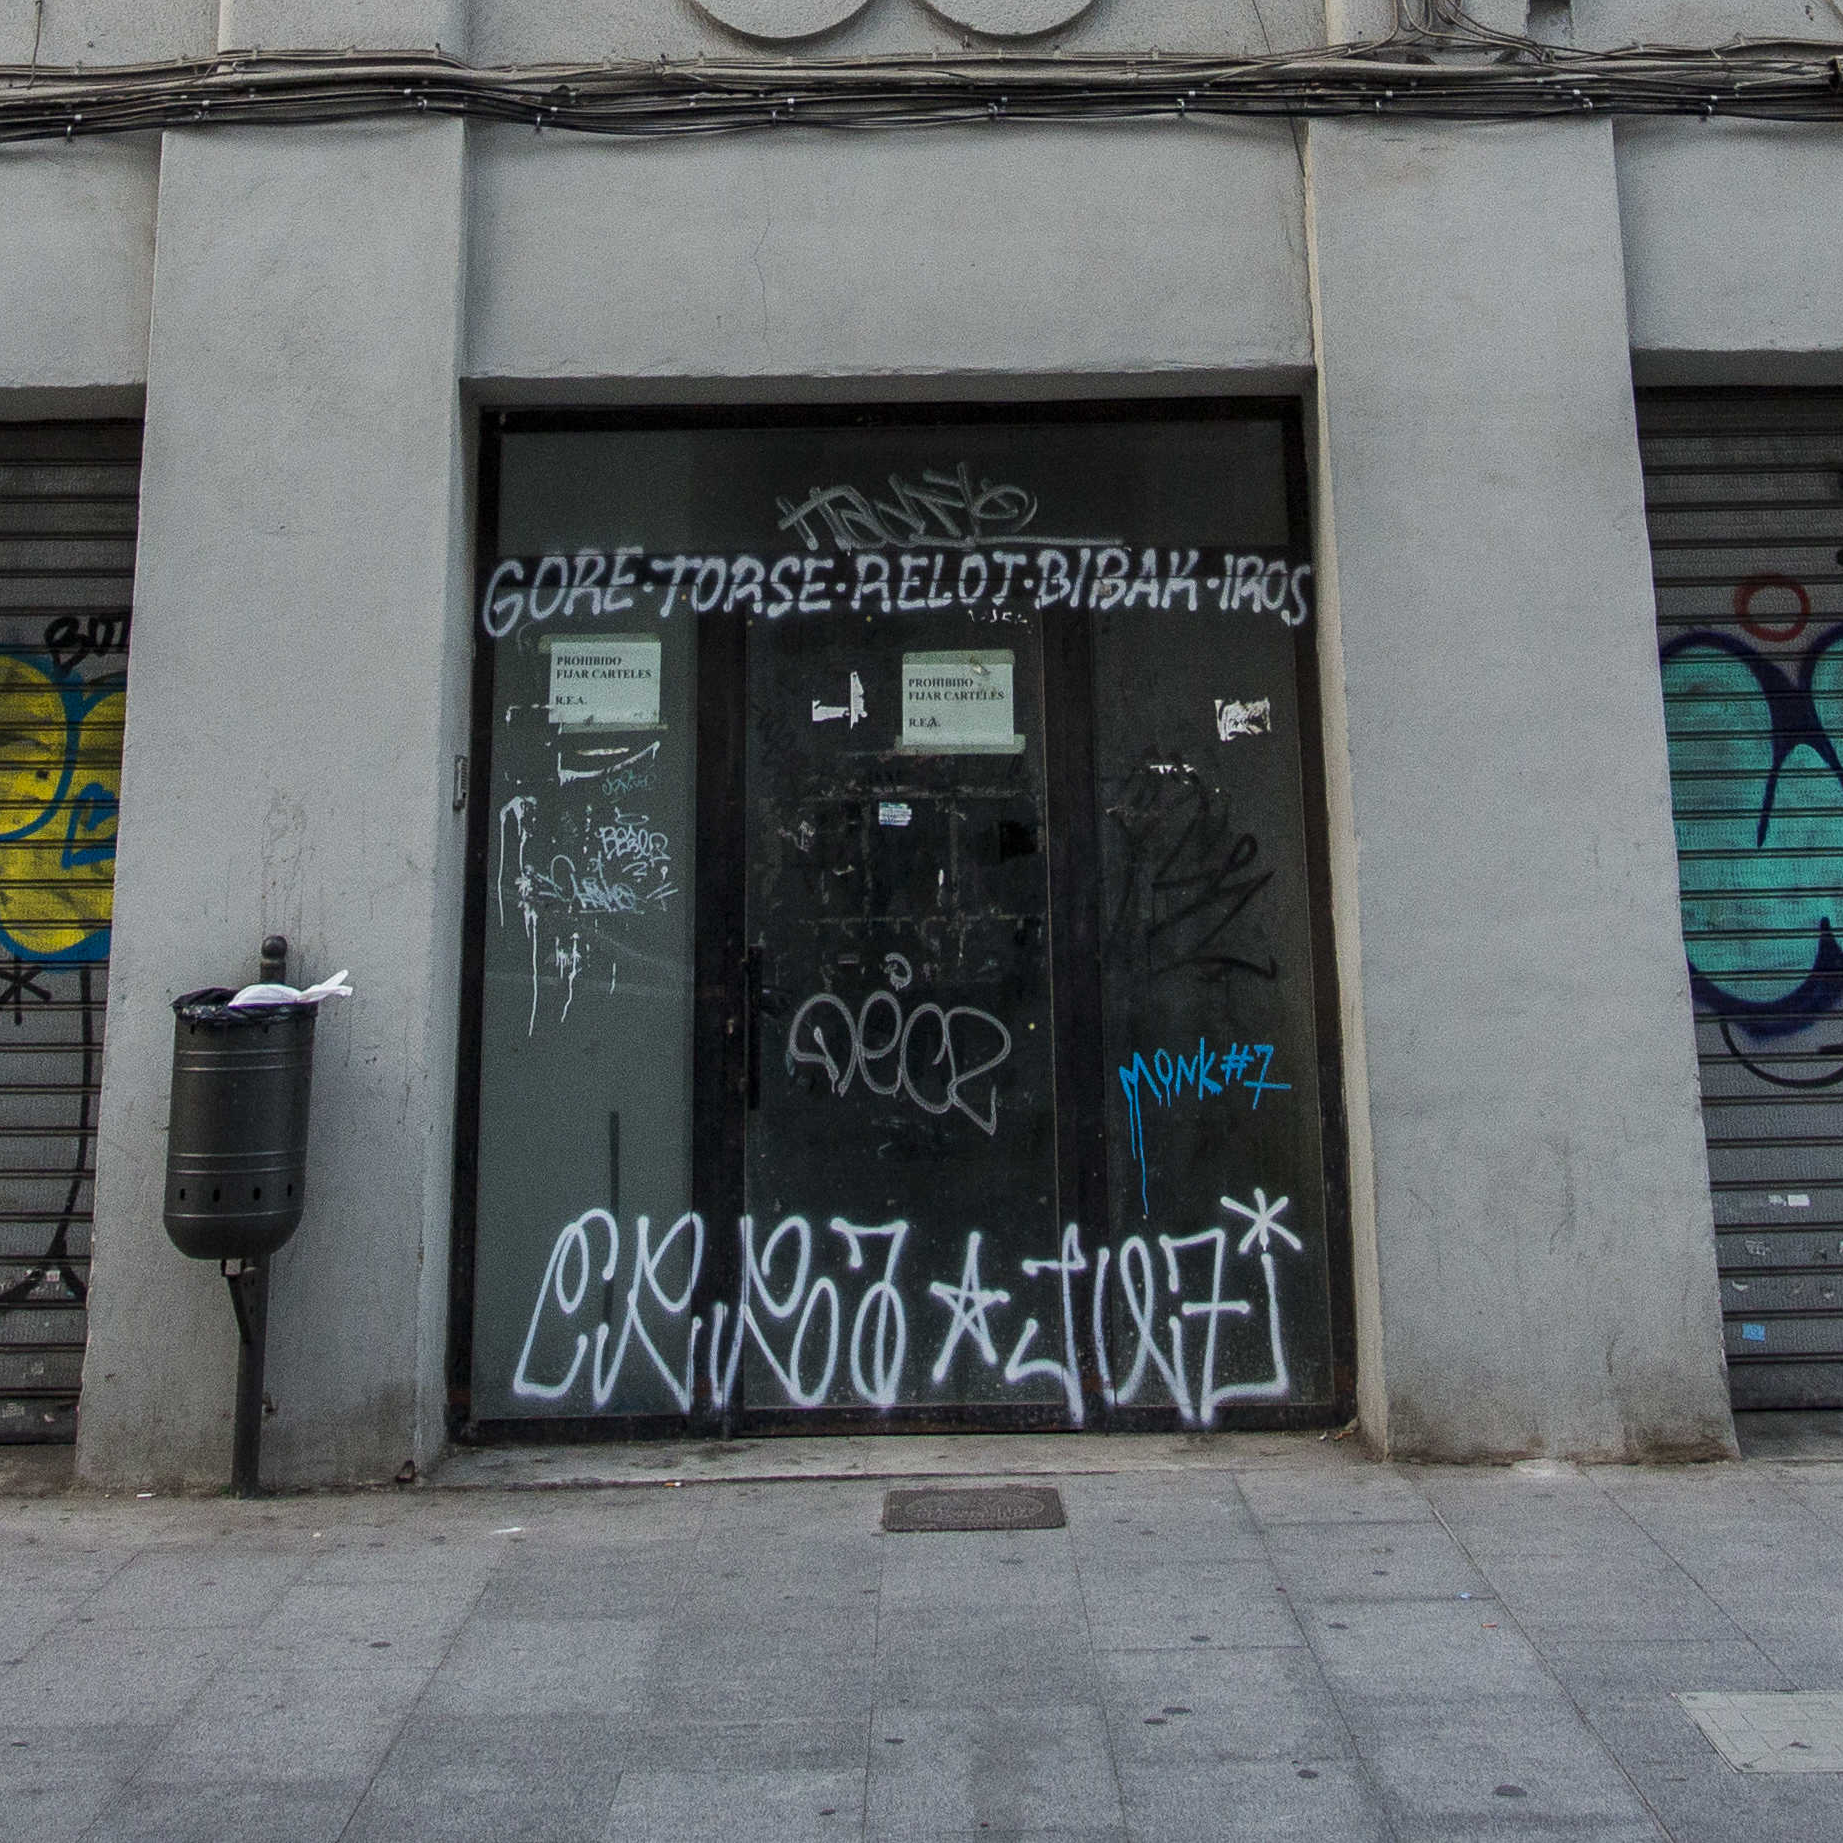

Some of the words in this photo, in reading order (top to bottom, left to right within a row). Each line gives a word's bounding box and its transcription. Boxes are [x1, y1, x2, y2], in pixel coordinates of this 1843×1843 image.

[556, 656, 623, 666] PROHIBIDO
[555, 669, 589, 679] FIJAR
[591, 669, 653, 679] CARTELES
[907, 677, 974, 688] PROHIBIDO
[907, 690, 941, 701] FIJAR
[943, 690, 1006, 701] CARTELES
